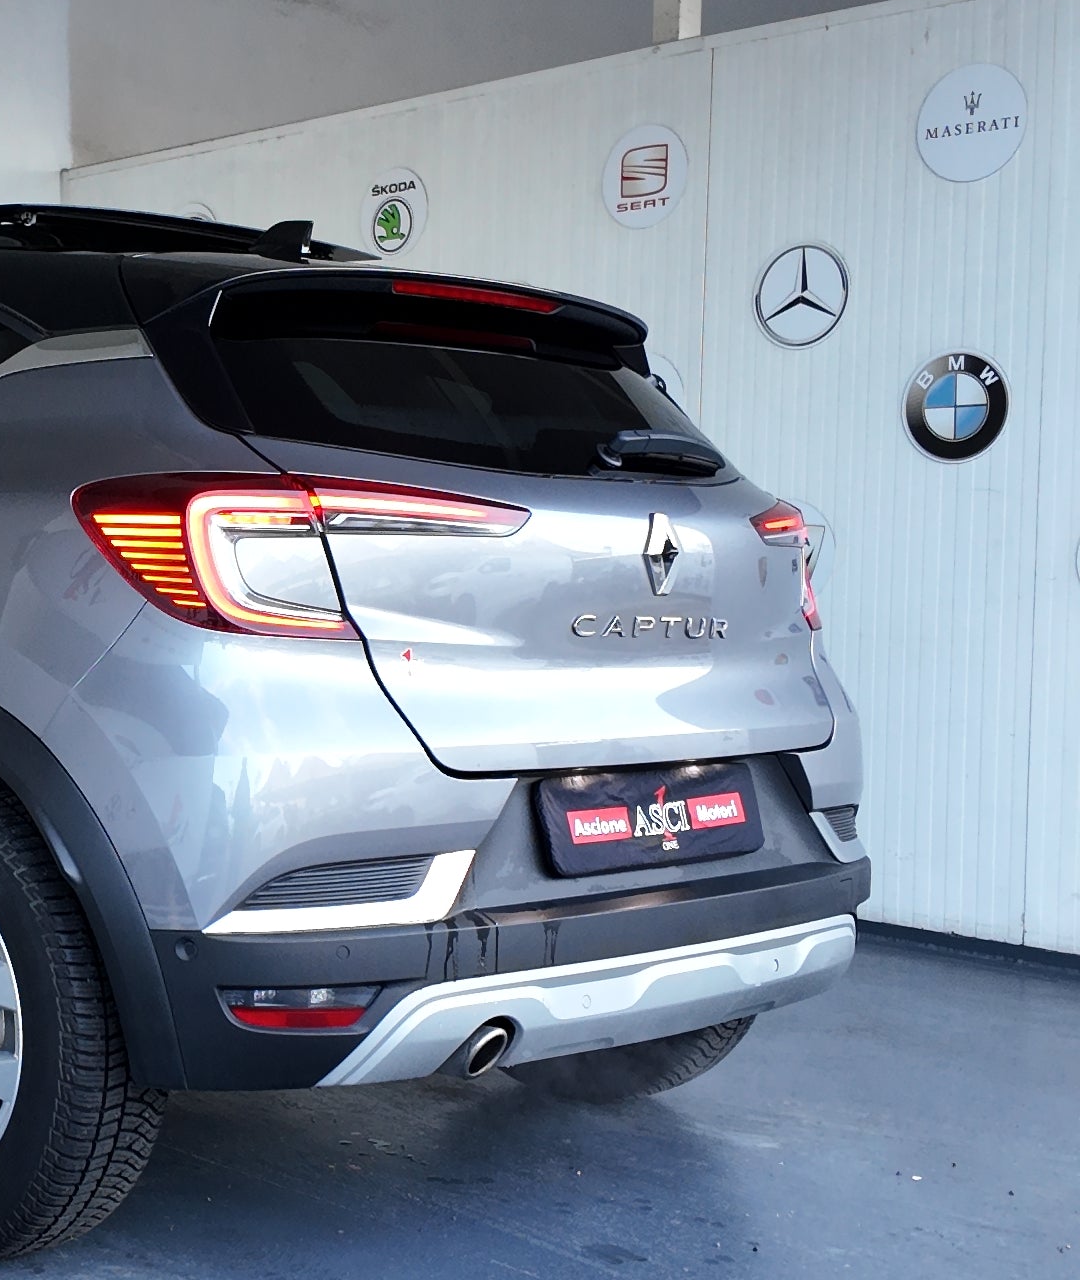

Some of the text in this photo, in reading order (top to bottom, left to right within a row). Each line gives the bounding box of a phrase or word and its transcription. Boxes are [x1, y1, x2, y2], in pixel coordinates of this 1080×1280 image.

[924, 115, 1020, 140] MASERATI
[371, 180, 417, 197] ŠKODA
[616, 197, 670, 213] SEAT
[915, 355, 1000, 390] BMW
[572, 614, 728, 639] CAPTUR
[574, 800, 738, 838] Ascione ASCI Motori
